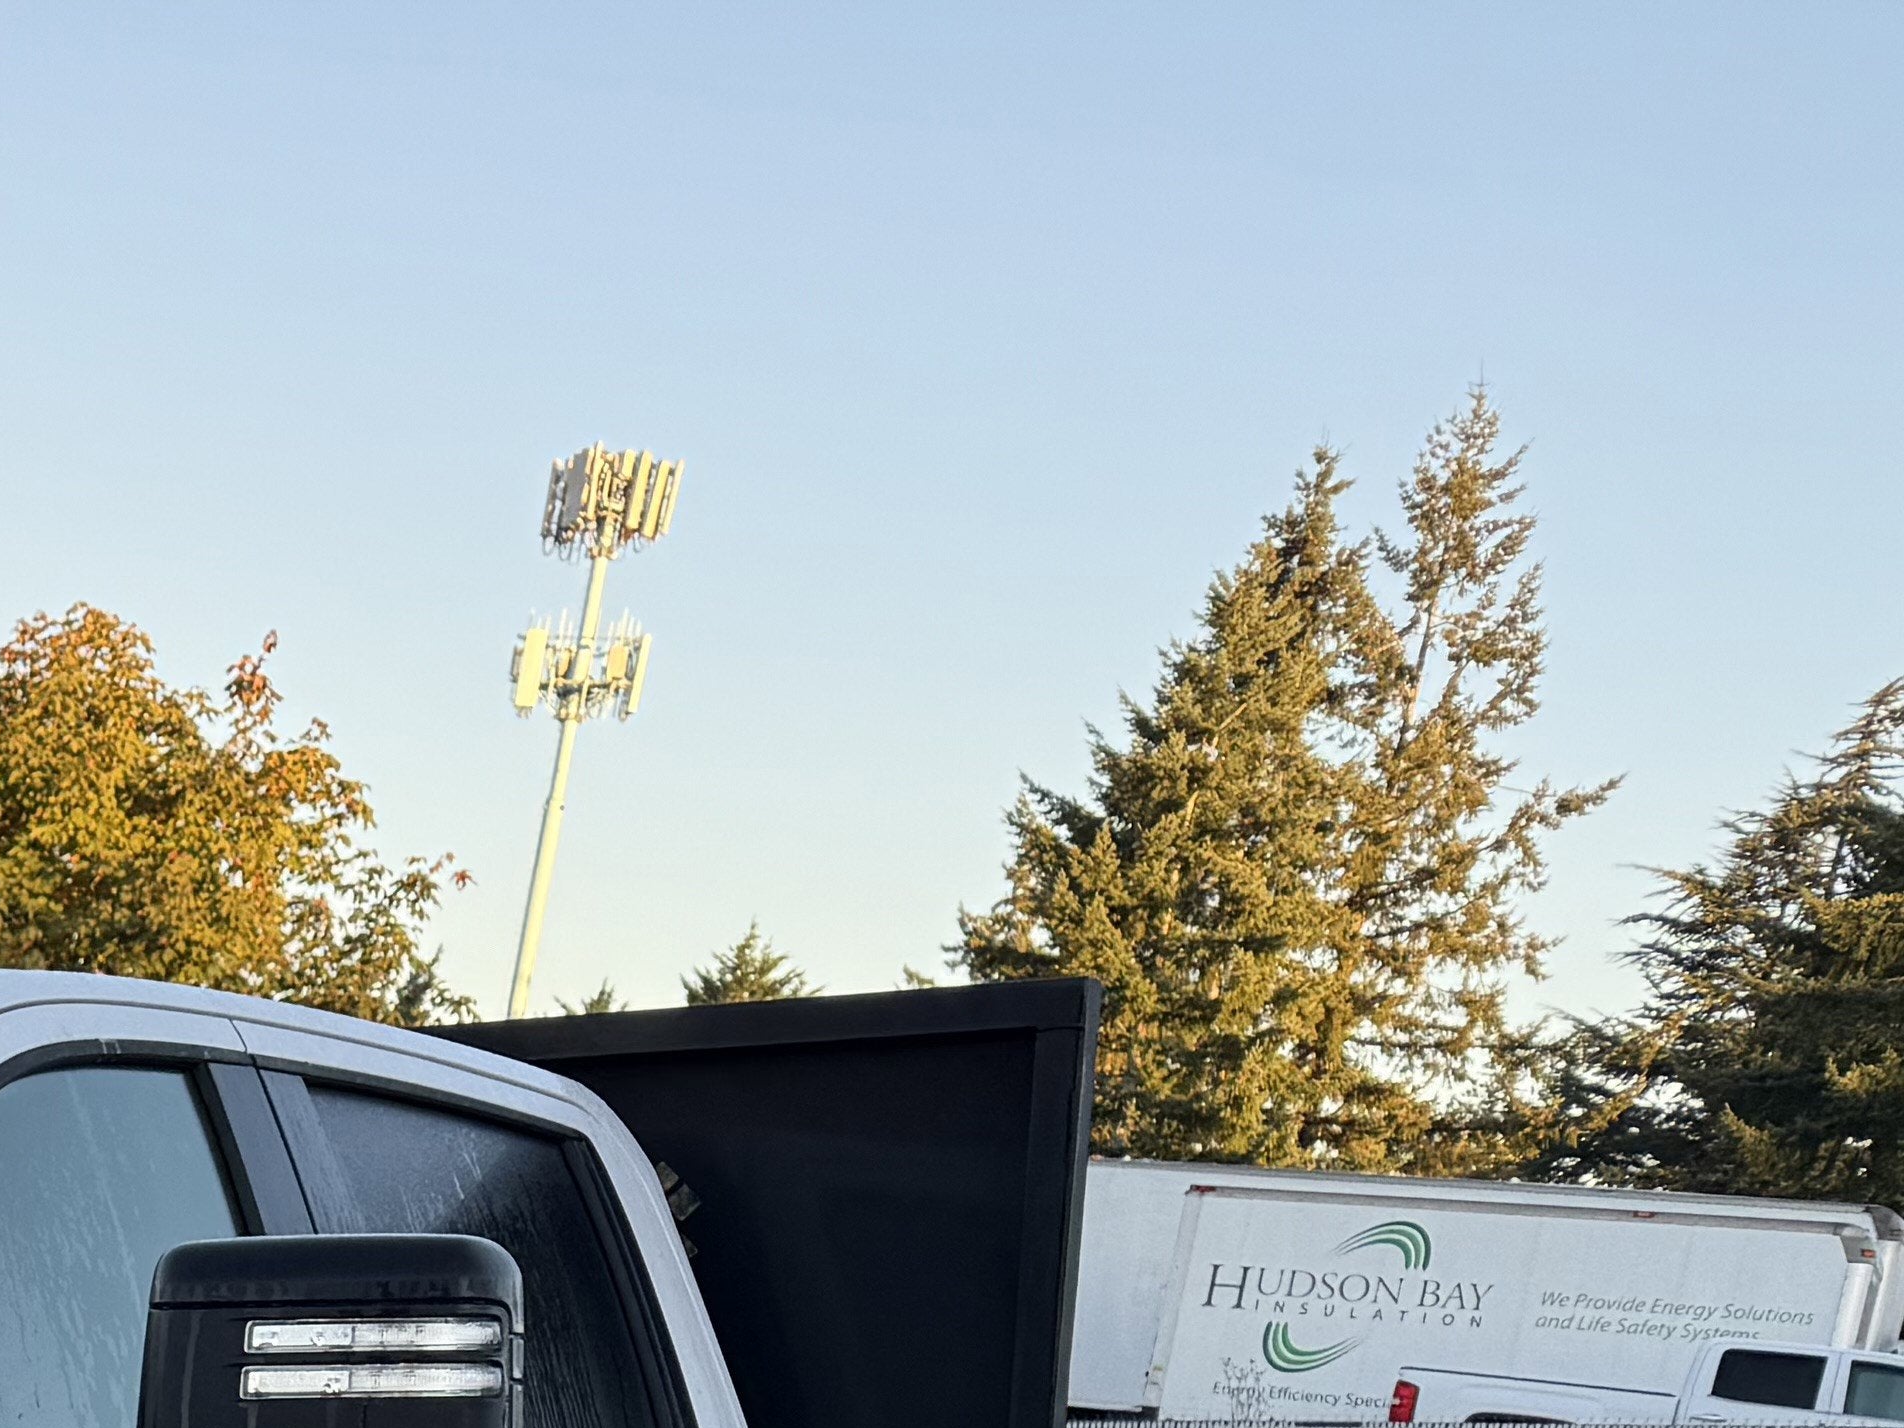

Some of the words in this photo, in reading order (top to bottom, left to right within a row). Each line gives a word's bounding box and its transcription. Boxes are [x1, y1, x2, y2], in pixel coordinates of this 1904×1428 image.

[1201, 1263, 1403, 1310] HUDSON
[1417, 1278, 1494, 1311] BAY
[1254, 1299, 1483, 1328] INSULATION
[1541, 1290, 1570, 1307] We
[1573, 1293, 1644, 1313] Provide
[1649, 1297, 1718, 1322] Energy
[1720, 1302, 1816, 1326] Solutions
[1534, 1314, 1574, 1331] and
[1575, 1315, 1610, 1333] Life
[1615, 1317, 1677, 1341] Safety
[1268, 1385, 1341, 1408] Efficiency
